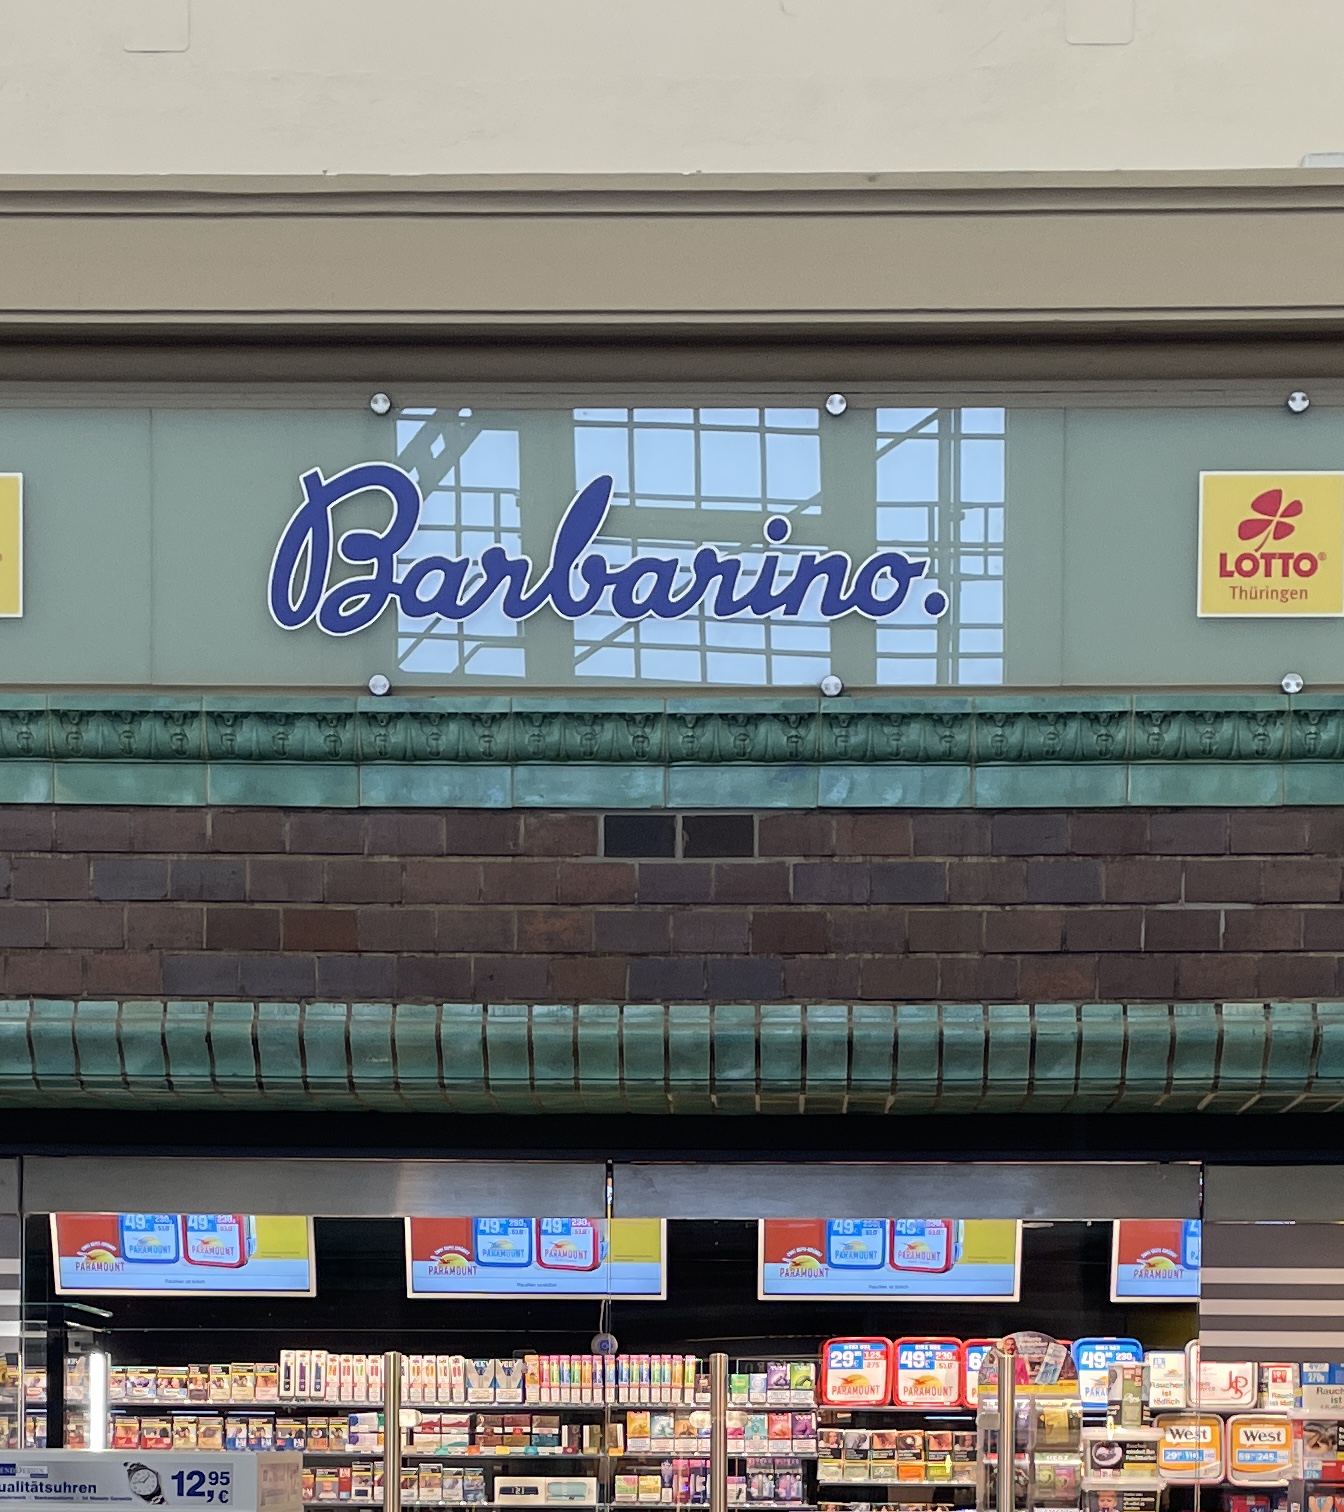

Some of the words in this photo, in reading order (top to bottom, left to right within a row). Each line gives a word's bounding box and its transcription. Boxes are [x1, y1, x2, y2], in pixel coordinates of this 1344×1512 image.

[268, 462, 947, 636] Barbarino.
[1219, 551, 1326, 578] LOTTO
[1229, 585, 1308, 603] Thüringen
[129, 1244, 171, 1255] PARAMOUNT
[191, 1246, 235, 1257] PARAMOUNT
[482, 1248, 524, 1259] PARAMOUNT
[544, 1249, 588, 1261] PARAMOUNT
[835, 1250, 878, 1260] PARAMOUNT
[897, 1251, 941, 1262] PARAMOUNT
[75, 1261, 125, 1273] PARAMOUNT
[428, 1265, 478, 1276] PARAMOUNT
[779, 1267, 829, 1278] PARAMOUNT
[1133, 1268, 1184, 1279] PARAMOUNT
[831, 1384, 881, 1395] PARAMOUNT
[903, 1386, 954, 1397] PARAMOUNT
[1331, 1396, 1342, 1404] ist
[1168, 1427, 1208, 1440] West
[1243, 1429, 1282, 1442] West
